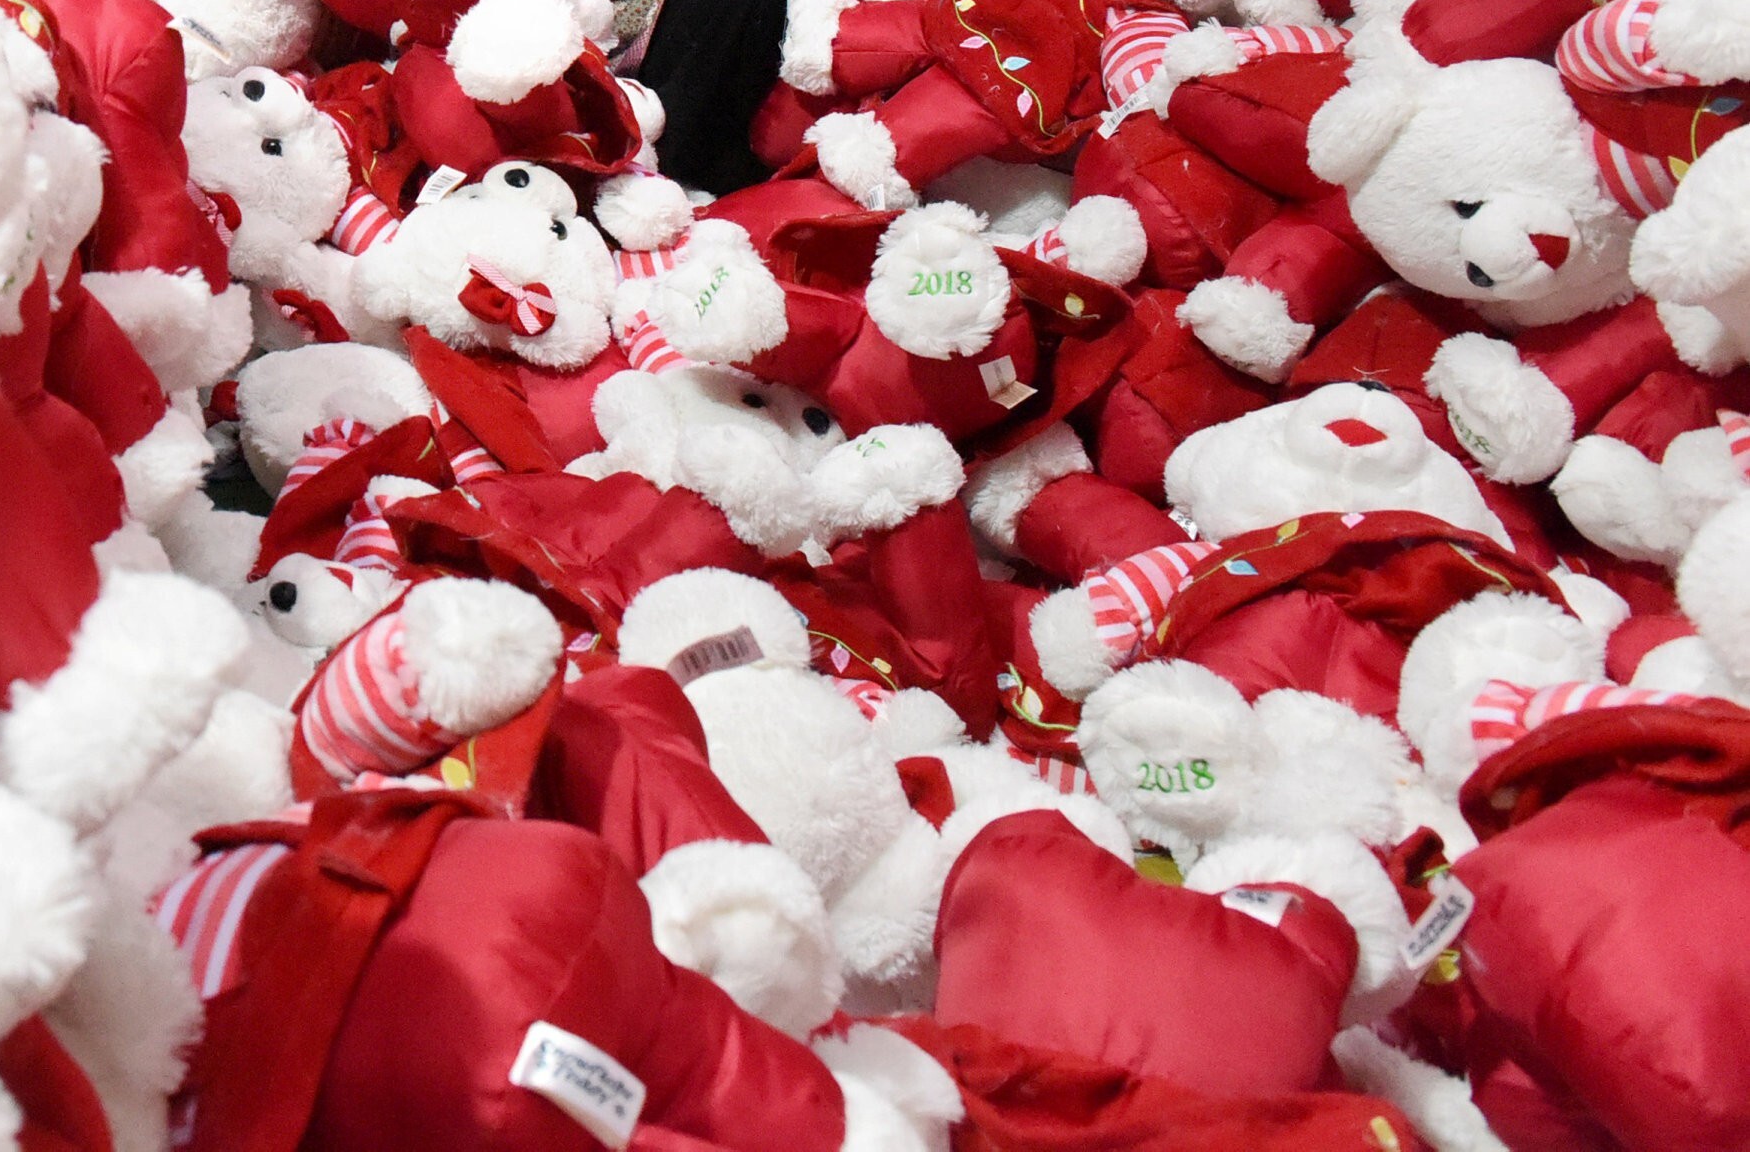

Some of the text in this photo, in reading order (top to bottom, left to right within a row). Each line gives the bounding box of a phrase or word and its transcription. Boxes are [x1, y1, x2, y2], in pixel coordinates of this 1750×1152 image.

[694, 265, 731, 322] 2018
[908, 269, 974, 297] 2018
[1138, 759, 1215, 794] 2018
